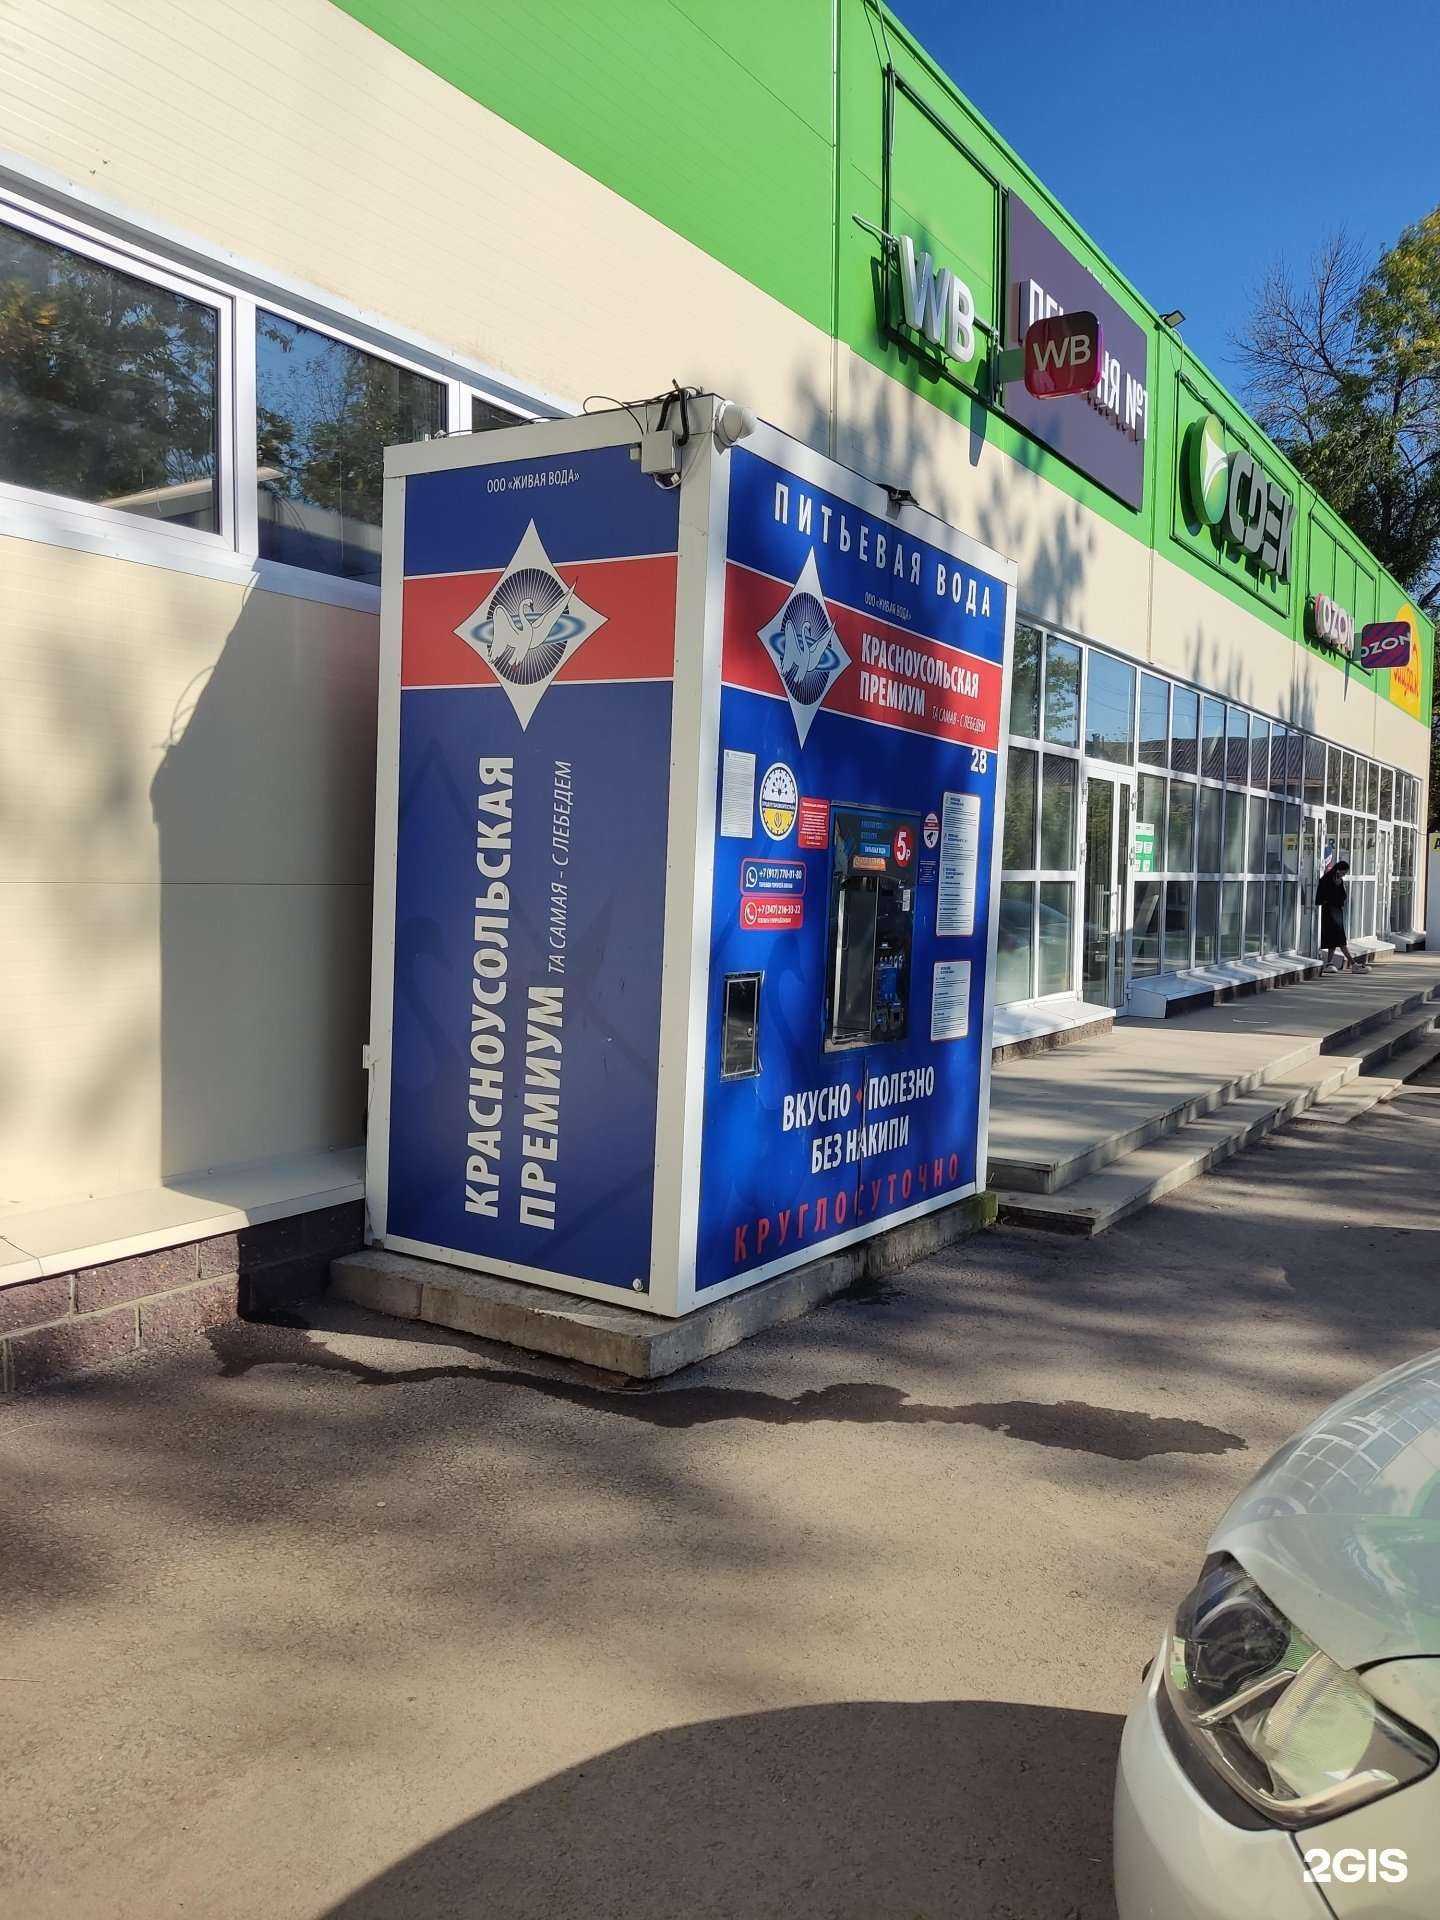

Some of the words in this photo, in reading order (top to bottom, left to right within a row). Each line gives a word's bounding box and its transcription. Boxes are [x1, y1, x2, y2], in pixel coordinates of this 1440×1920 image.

[900, 234, 975, 363] WB
[1032, 334, 1091, 372] WB
[487, 477, 506, 493] ООО
[508, 472, 546, 490] «ЖИВАЯ
[548, 468, 580, 487] ВОДА»
[773, 481, 921, 587] ПИТЬЕВАЯ
[935, 563, 991, 618] ВОДА
[859, 671, 926, 717] ПРЕМИУМ
[861, 633, 980, 699] КРАСНОУСОЛЬСКАЯ
[970, 749, 987, 774] 28
[553, 760, 574, 853] ЛЕБЕДЕМ
[552, 852, 569, 867] С
[549, 881, 569, 949] САМАЯ
[464, 757, 514, 1218] КРАСНОУСОЛЬСКАЯ
[548, 954, 566, 975] ТА
[519, 986, 565, 1231] ПРЕМИУМ
[782, 1083, 851, 1132] ВКУСНО
[868, 1066, 935, 1111] ПОЛЕЗНО
[811, 1132, 842, 1174] БЕЗ
[845, 1115, 910, 1164] НАКИПИ
[734, 1153, 959, 1264] КРУГЛОСУТОЧНО
